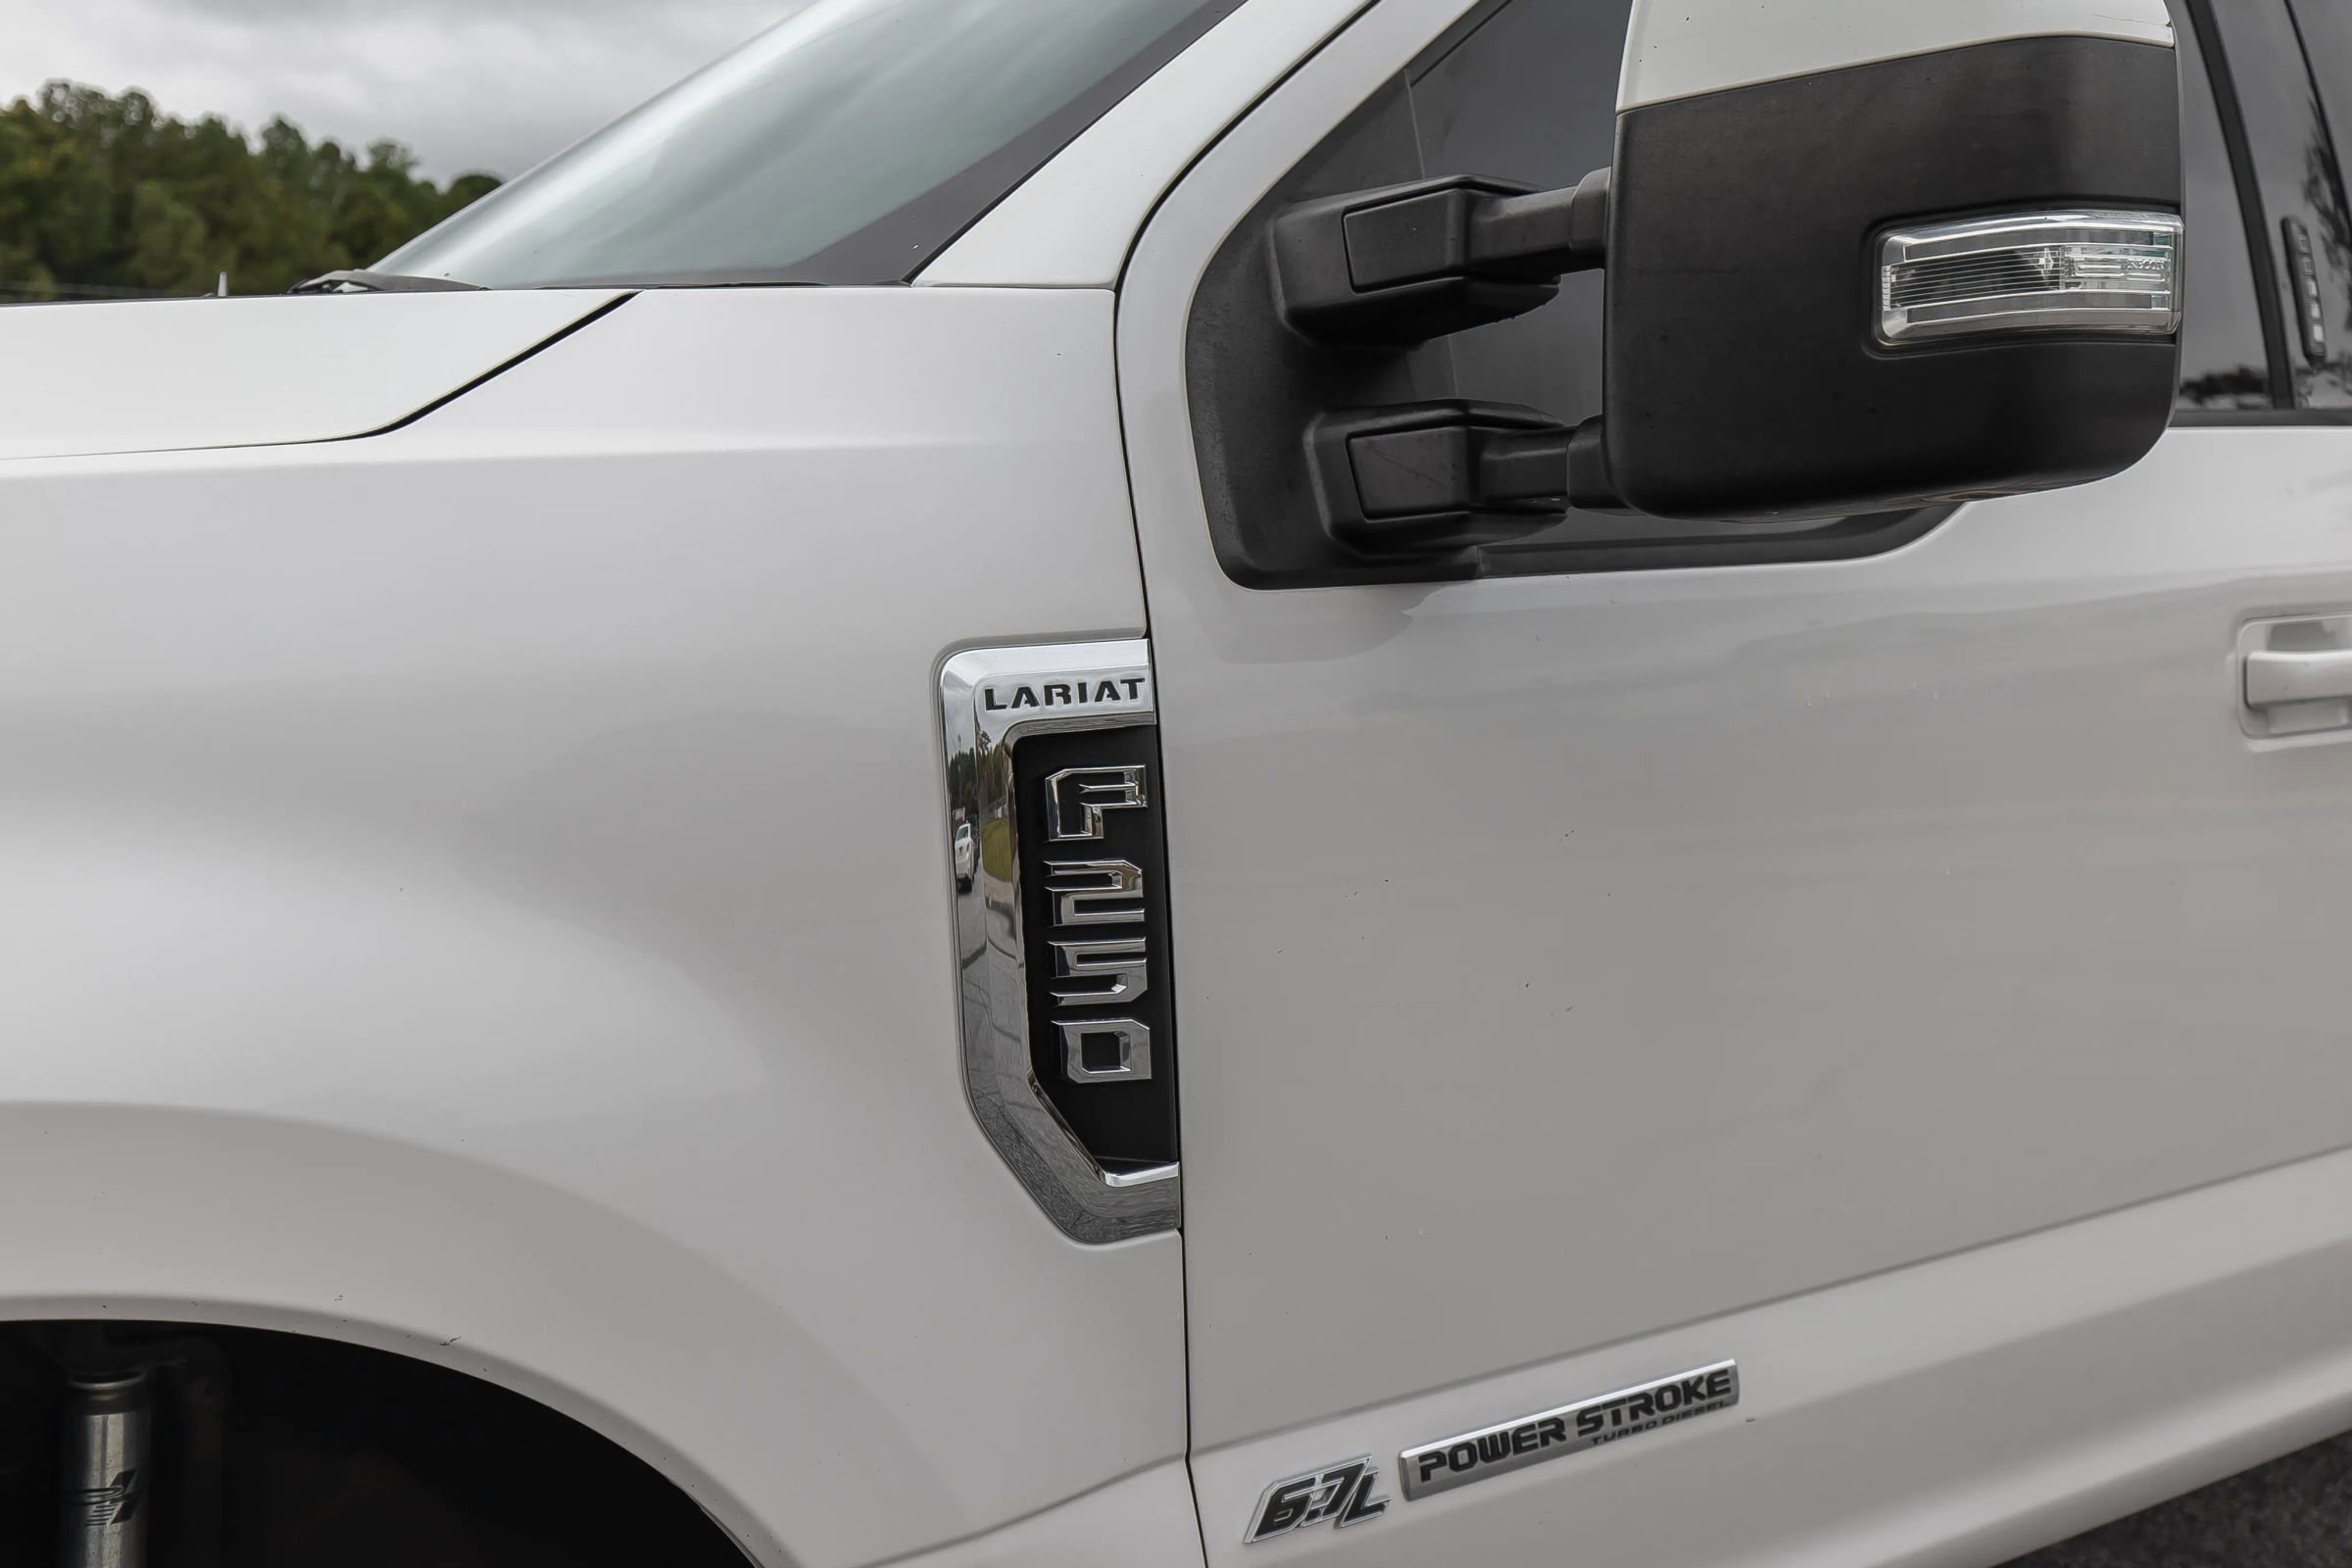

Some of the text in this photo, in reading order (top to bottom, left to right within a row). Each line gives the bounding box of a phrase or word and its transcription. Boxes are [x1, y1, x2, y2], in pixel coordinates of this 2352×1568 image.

[984, 677, 1146, 711] LARIAT
[1043, 763, 1152, 1084] F250
[1418, 1368, 1732, 1484] POWER STROKE
[1591, 1399, 1726, 1446] TURBO DIESEL
[1244, 1453, 1392, 1544] 6.7L
